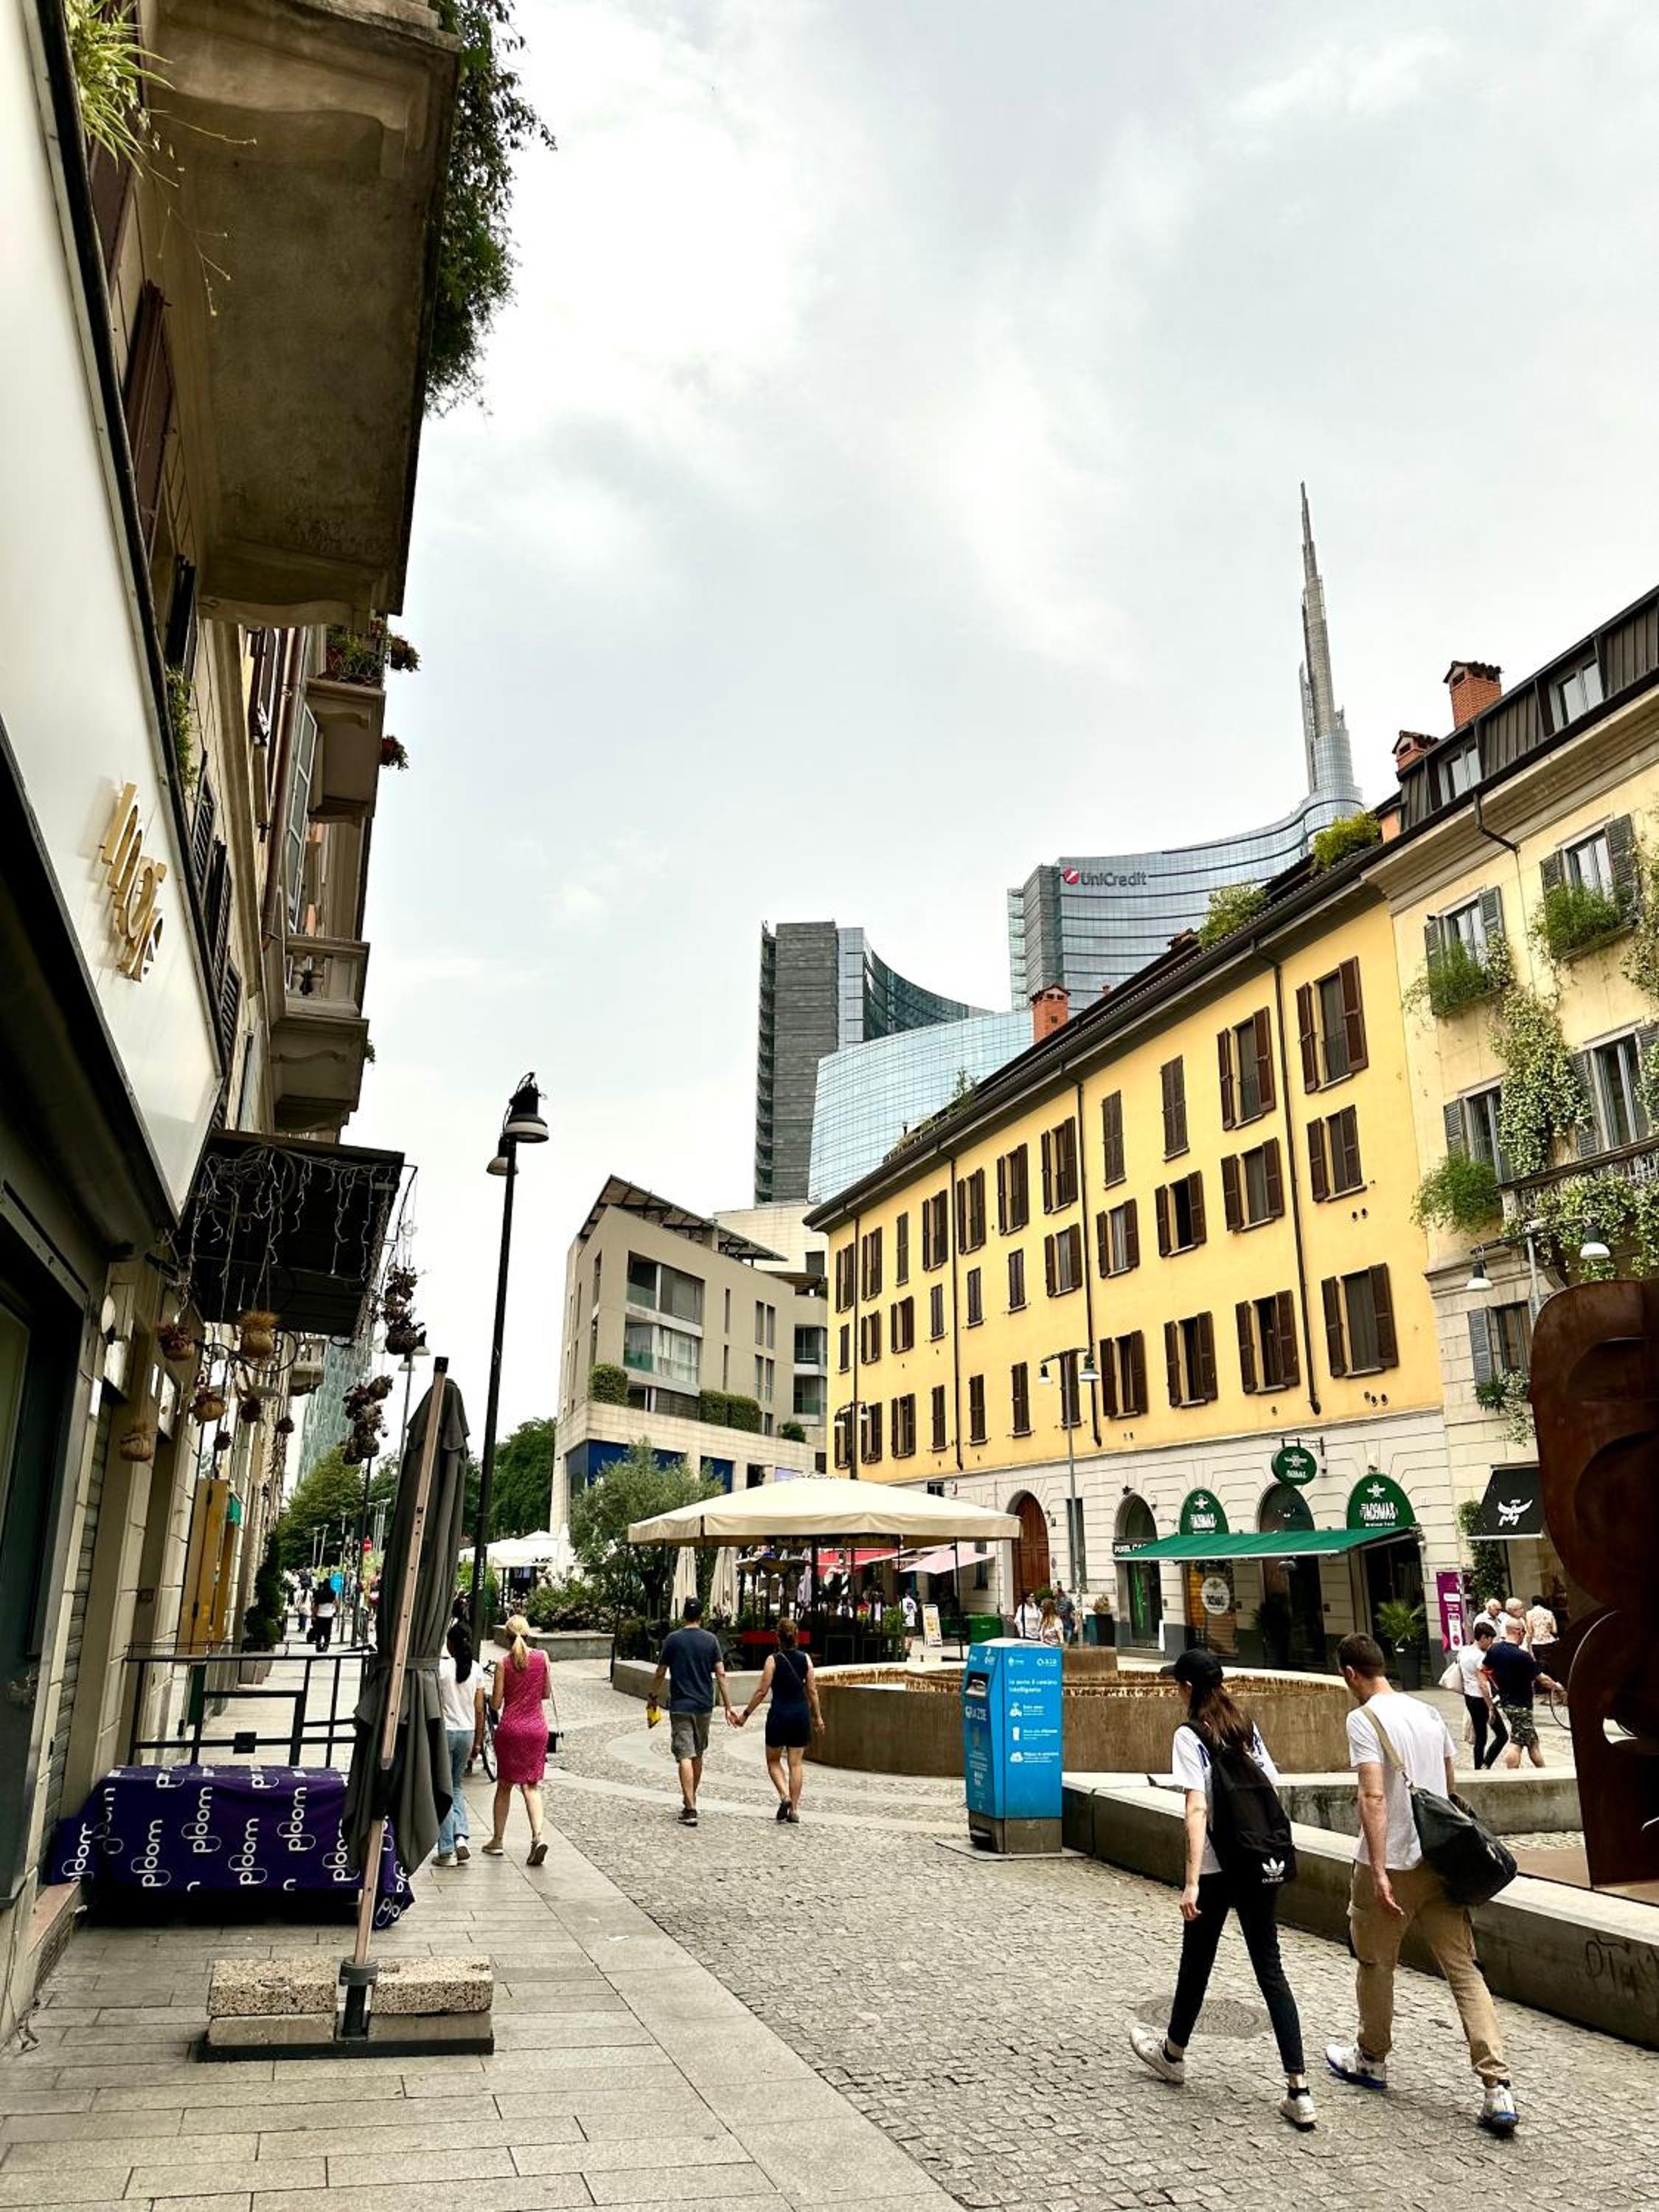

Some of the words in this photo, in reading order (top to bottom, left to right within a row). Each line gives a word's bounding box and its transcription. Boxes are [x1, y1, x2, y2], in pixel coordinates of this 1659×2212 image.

[1081, 871, 1147, 886] UniCredit
[181, 1787, 221, 1853] ploom
[228, 1818, 268, 1885] ploom
[277, 1787, 316, 1851] ploom
[131, 1819, 171, 1887] ploom
